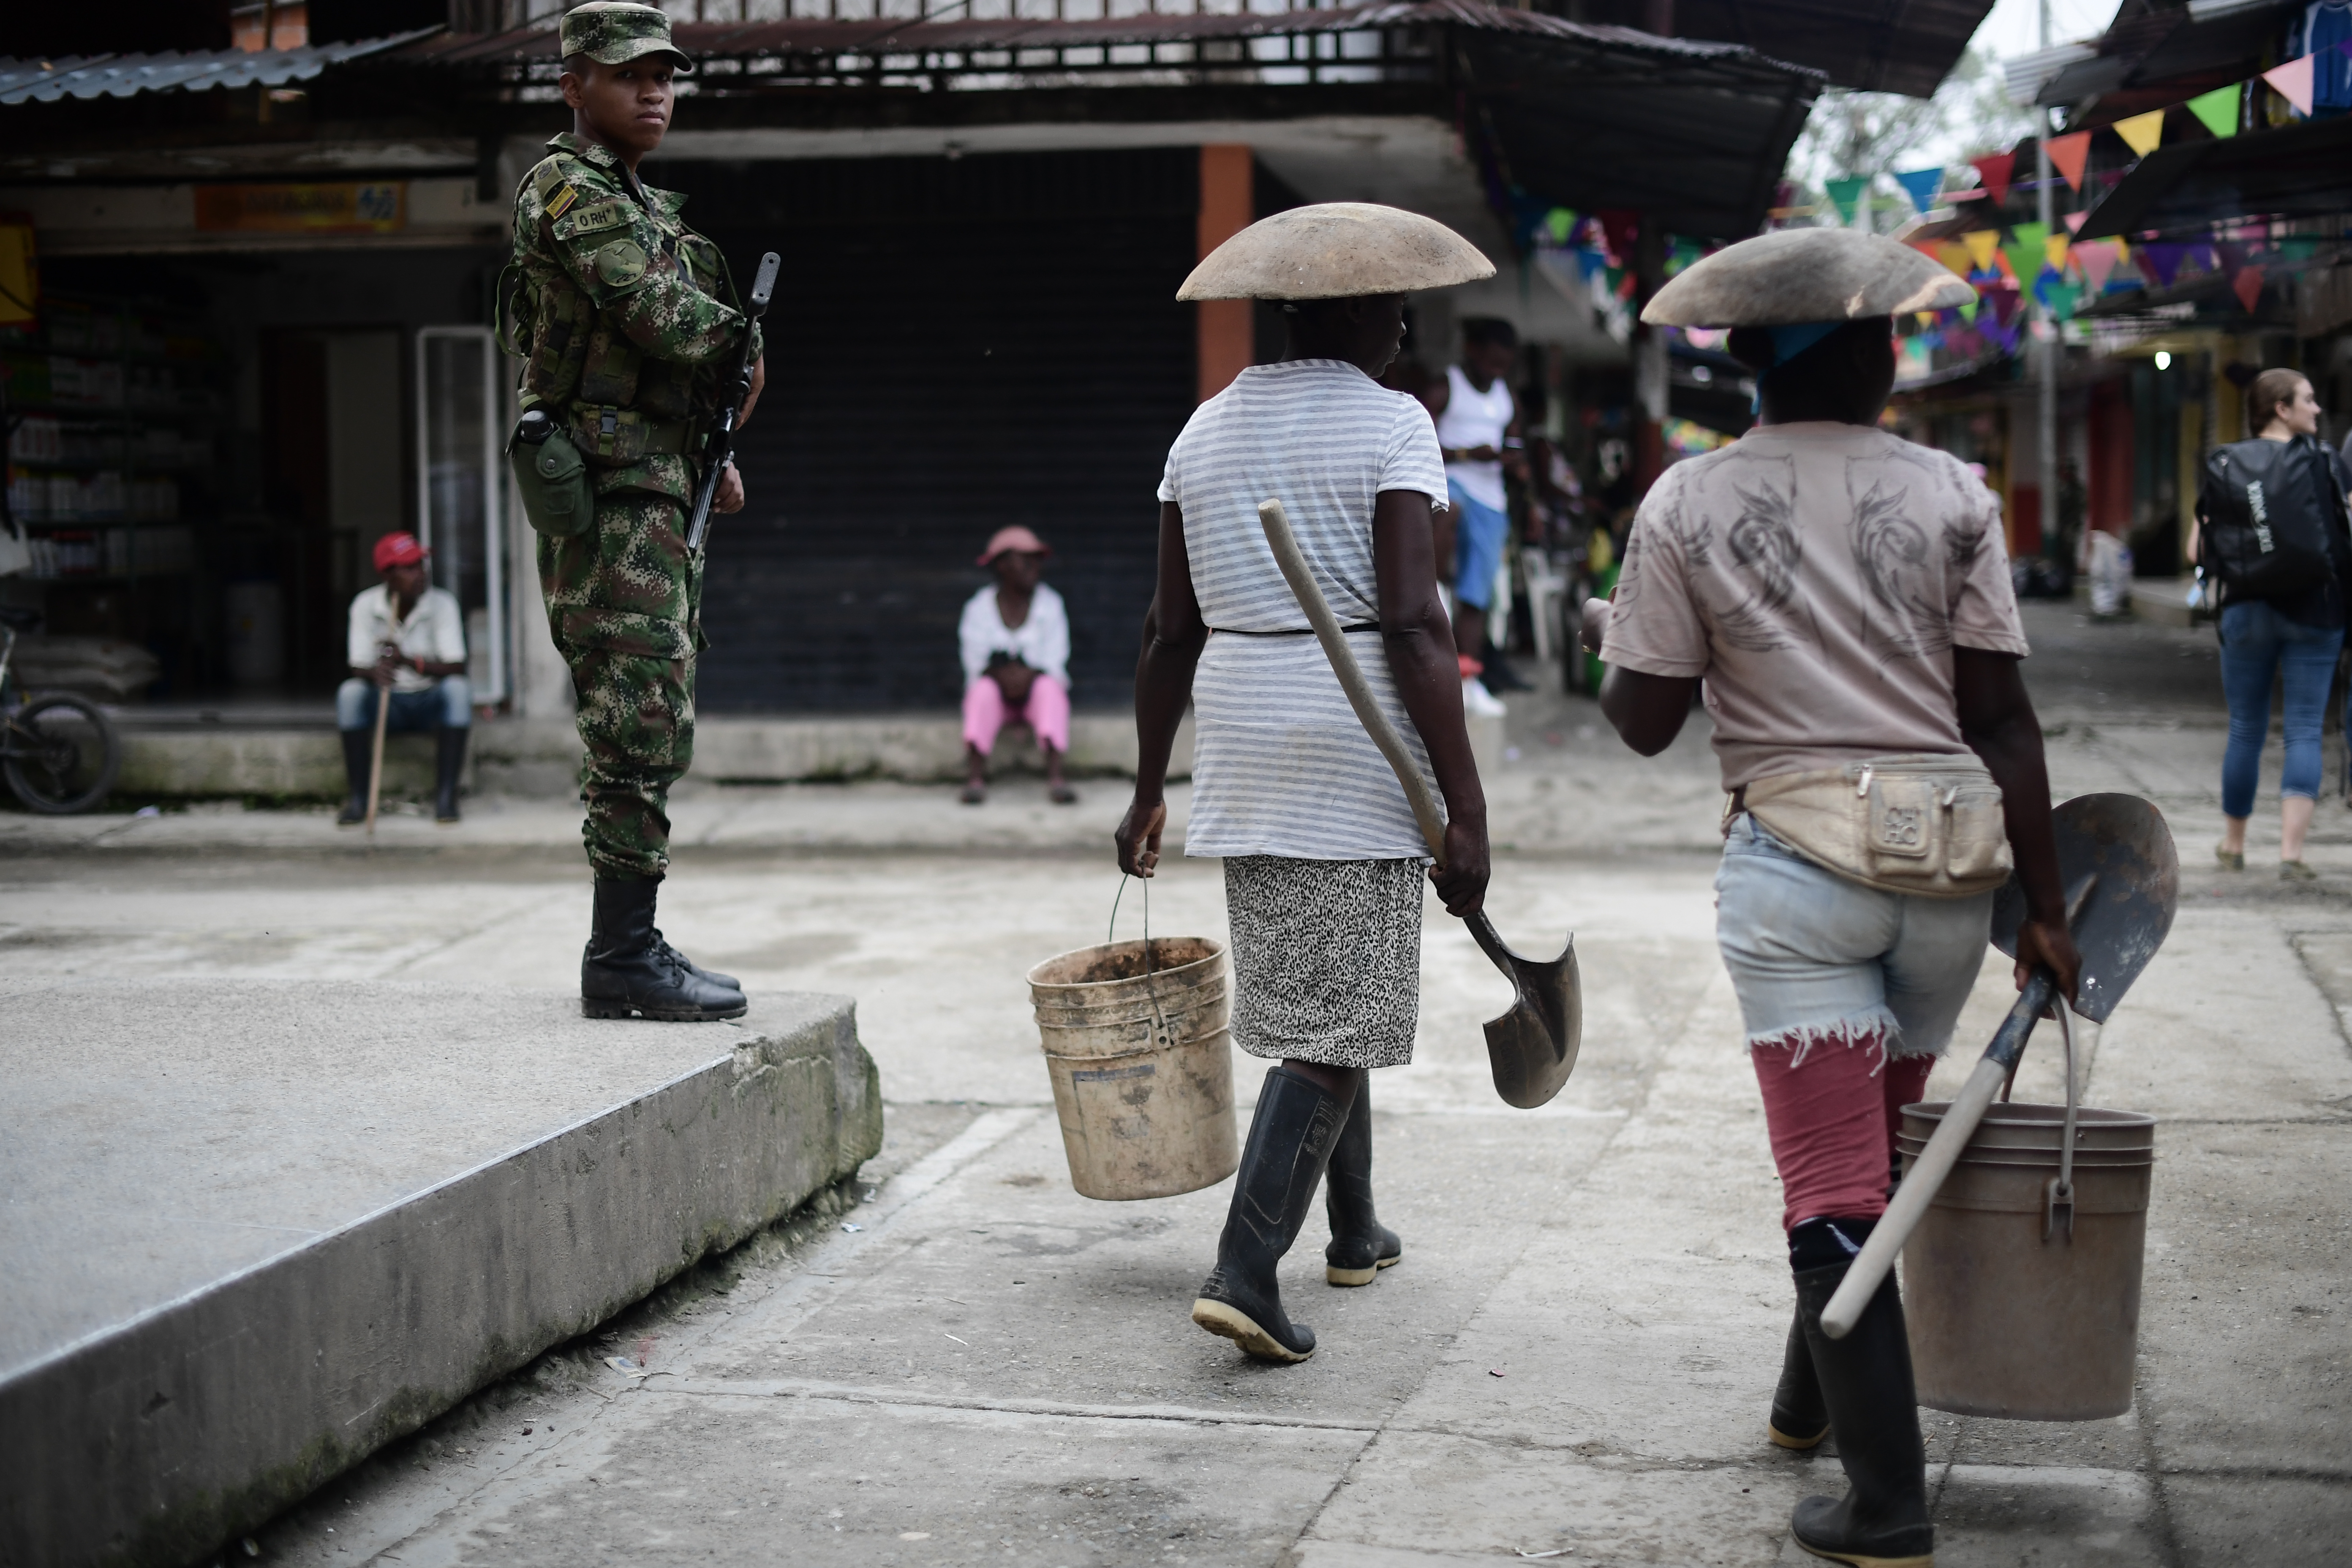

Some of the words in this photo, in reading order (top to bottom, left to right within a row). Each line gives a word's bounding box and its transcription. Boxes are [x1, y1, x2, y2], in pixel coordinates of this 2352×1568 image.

[550, 188, 570, 211] COLOA
[590, 208, 611, 225] RH+
[1884, 824, 1916, 844] HC
